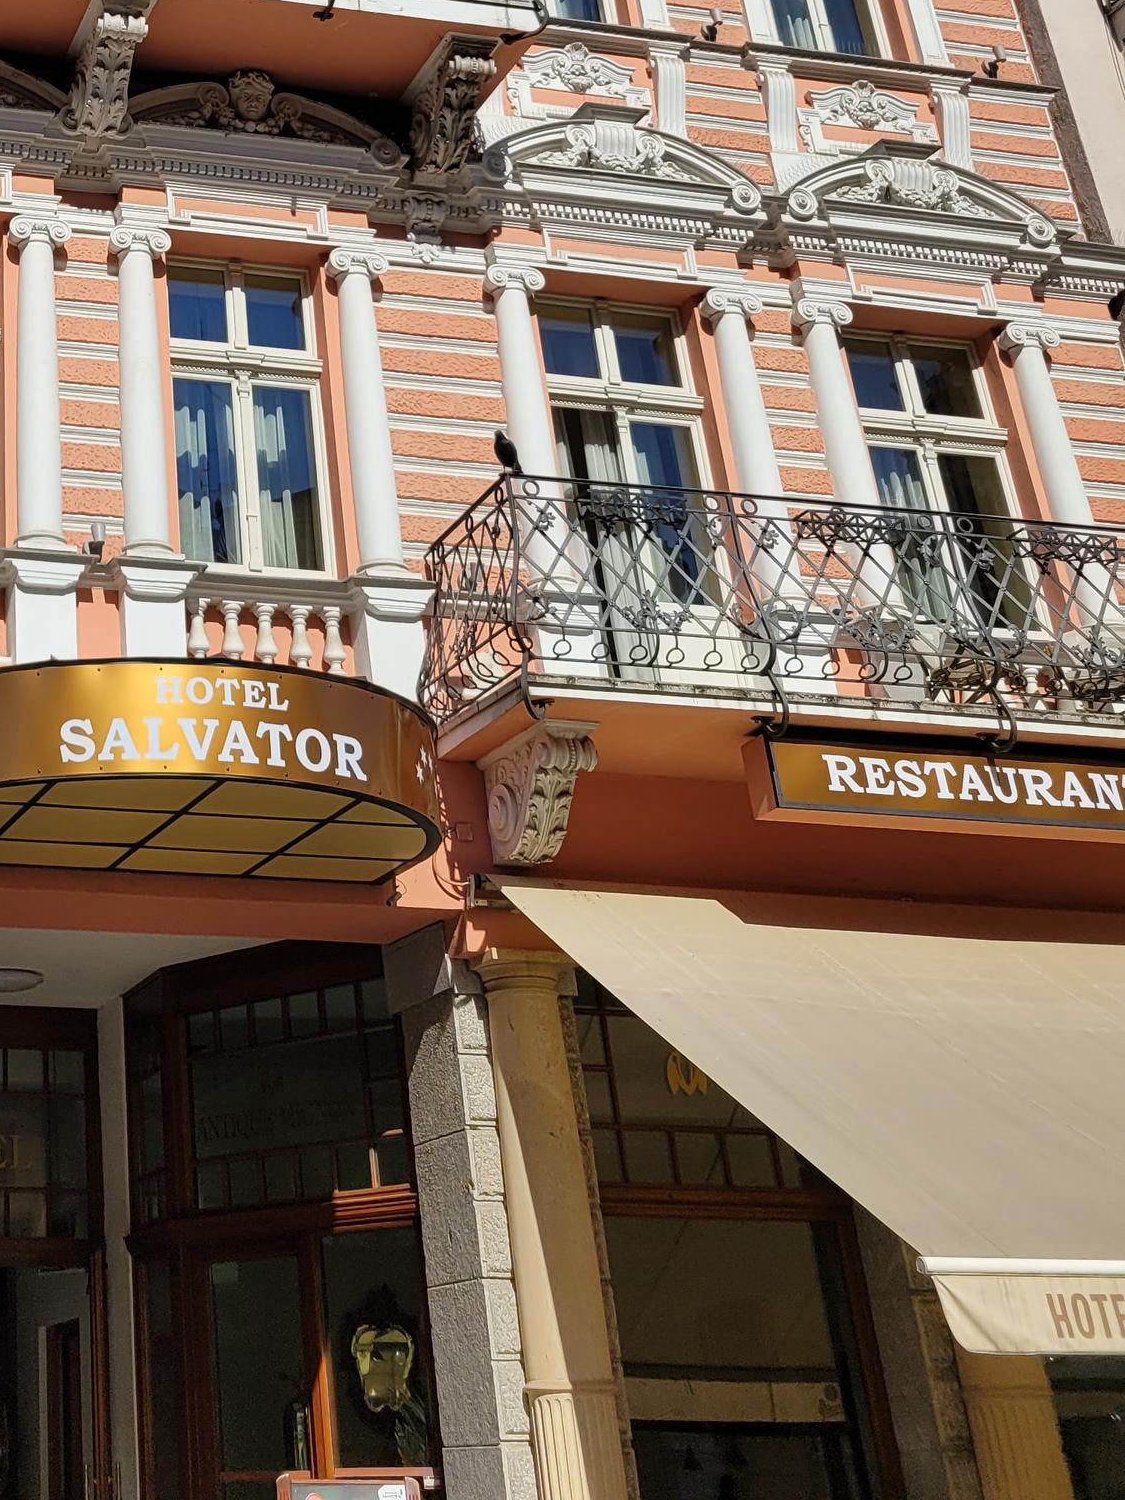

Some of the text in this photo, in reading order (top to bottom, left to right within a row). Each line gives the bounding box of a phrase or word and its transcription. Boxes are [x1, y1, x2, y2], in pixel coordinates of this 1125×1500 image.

[155, 675, 290, 712] HOTEL
[59, 717, 368, 782] SALVATOR
[821, 753, 1125, 811] RESTAURAN
